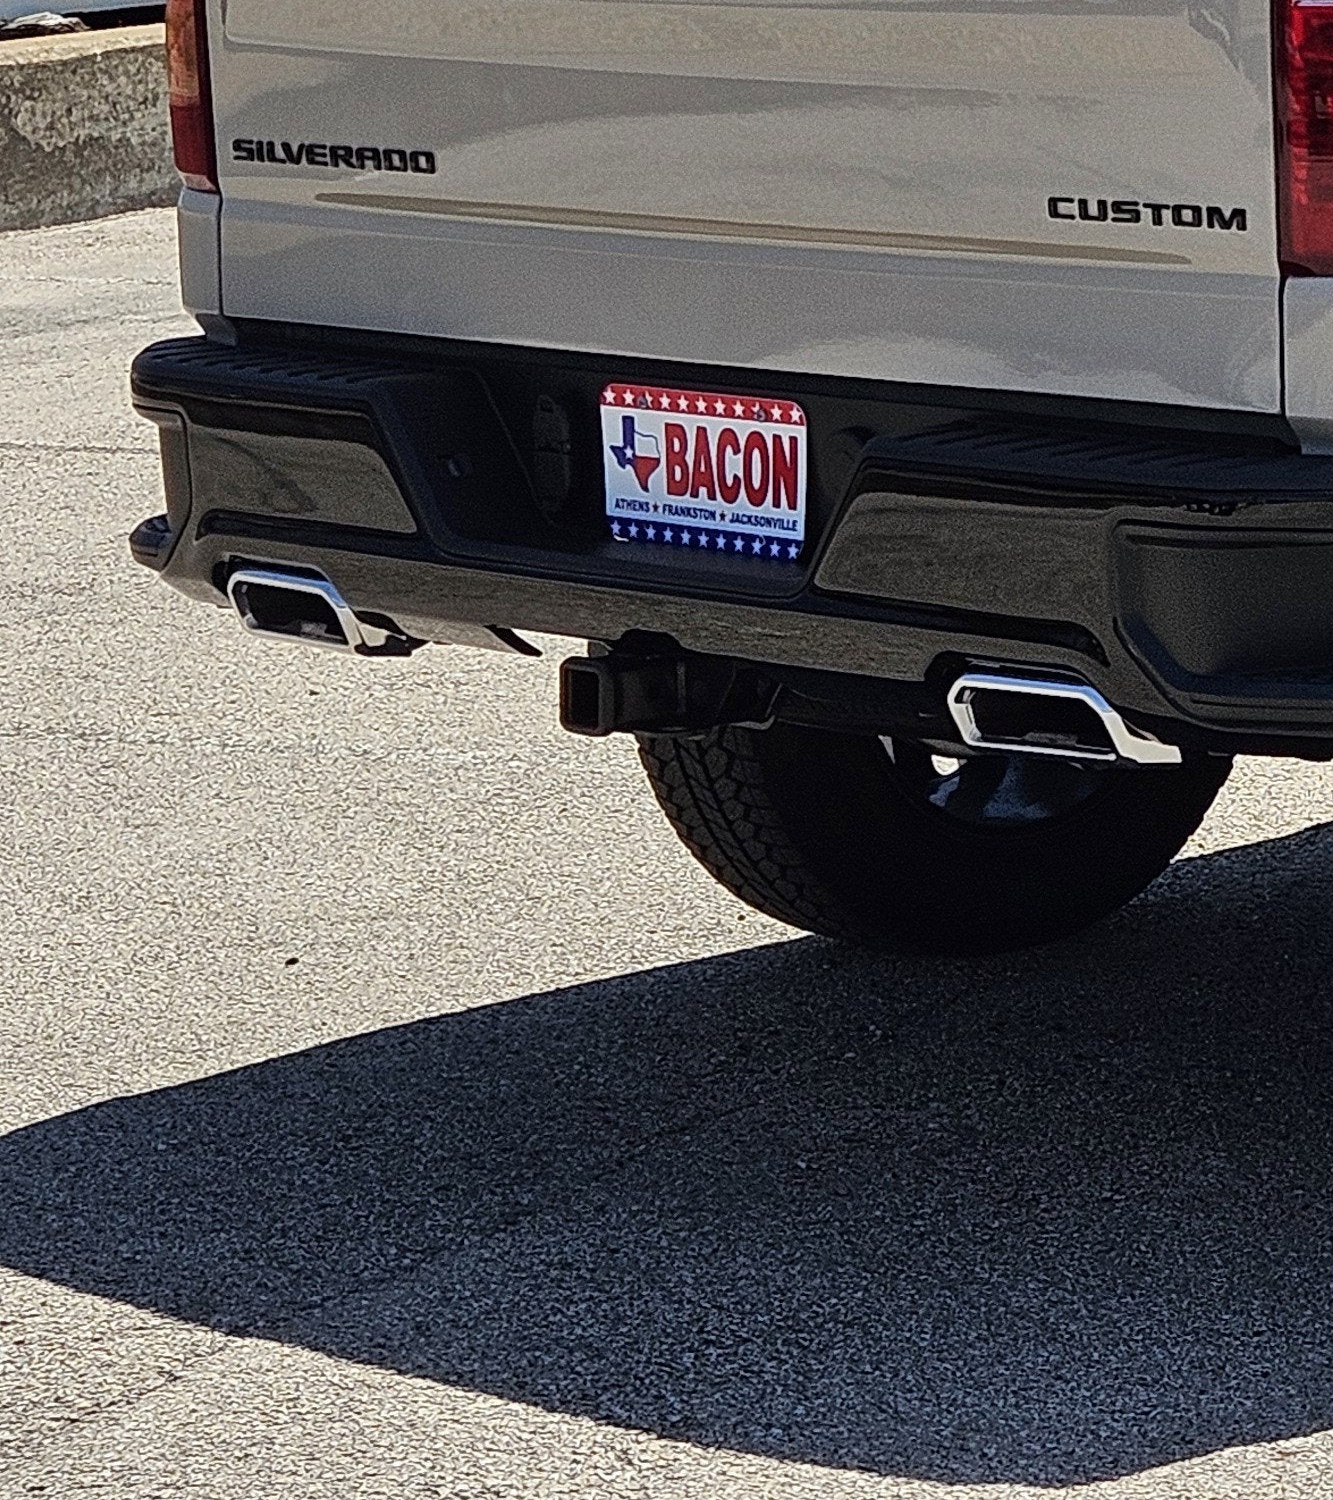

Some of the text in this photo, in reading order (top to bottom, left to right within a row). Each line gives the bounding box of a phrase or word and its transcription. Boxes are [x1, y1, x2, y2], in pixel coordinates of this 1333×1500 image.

[232, 138, 436, 175] SILVERADO
[1047, 197, 1247, 231] CUSTOM
[664, 421, 799, 511] BACON
[614, 498, 798, 532] ATHENS FRANKSTON JACKSONVILLE
